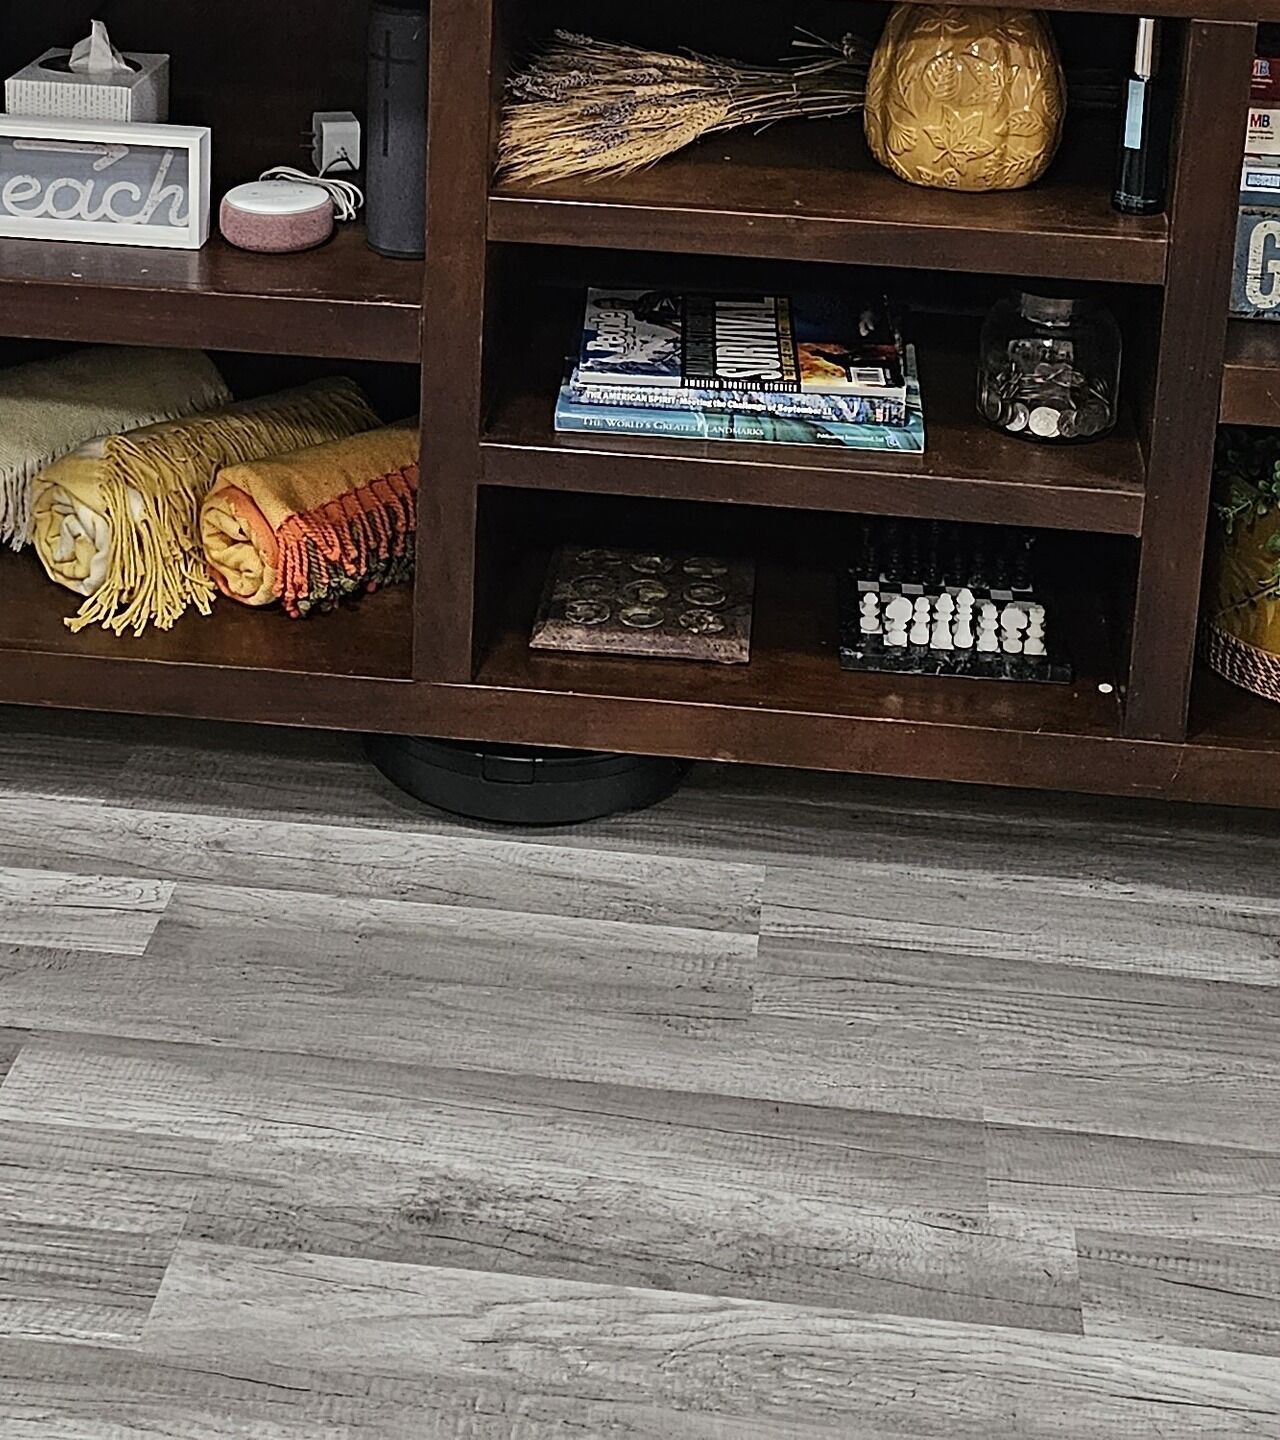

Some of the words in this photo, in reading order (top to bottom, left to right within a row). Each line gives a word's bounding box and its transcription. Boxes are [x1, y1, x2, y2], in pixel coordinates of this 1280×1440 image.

[1250, 113, 1272, 129] MB
[586, 312, 634, 353] People
[715, 297, 782, 380] SURVIVAL
[586, 390, 601, 401] THE
[602, 391, 648, 404] AMERICAN
[680, 396, 712, 409] Meeting
[713, 399, 727, 410] the
[727, 400, 767, 414] Challenge
[777, 404, 822, 418] September
[823, 407, 833, 417] 11
[705, 425, 764, 438] LANDMARKS
